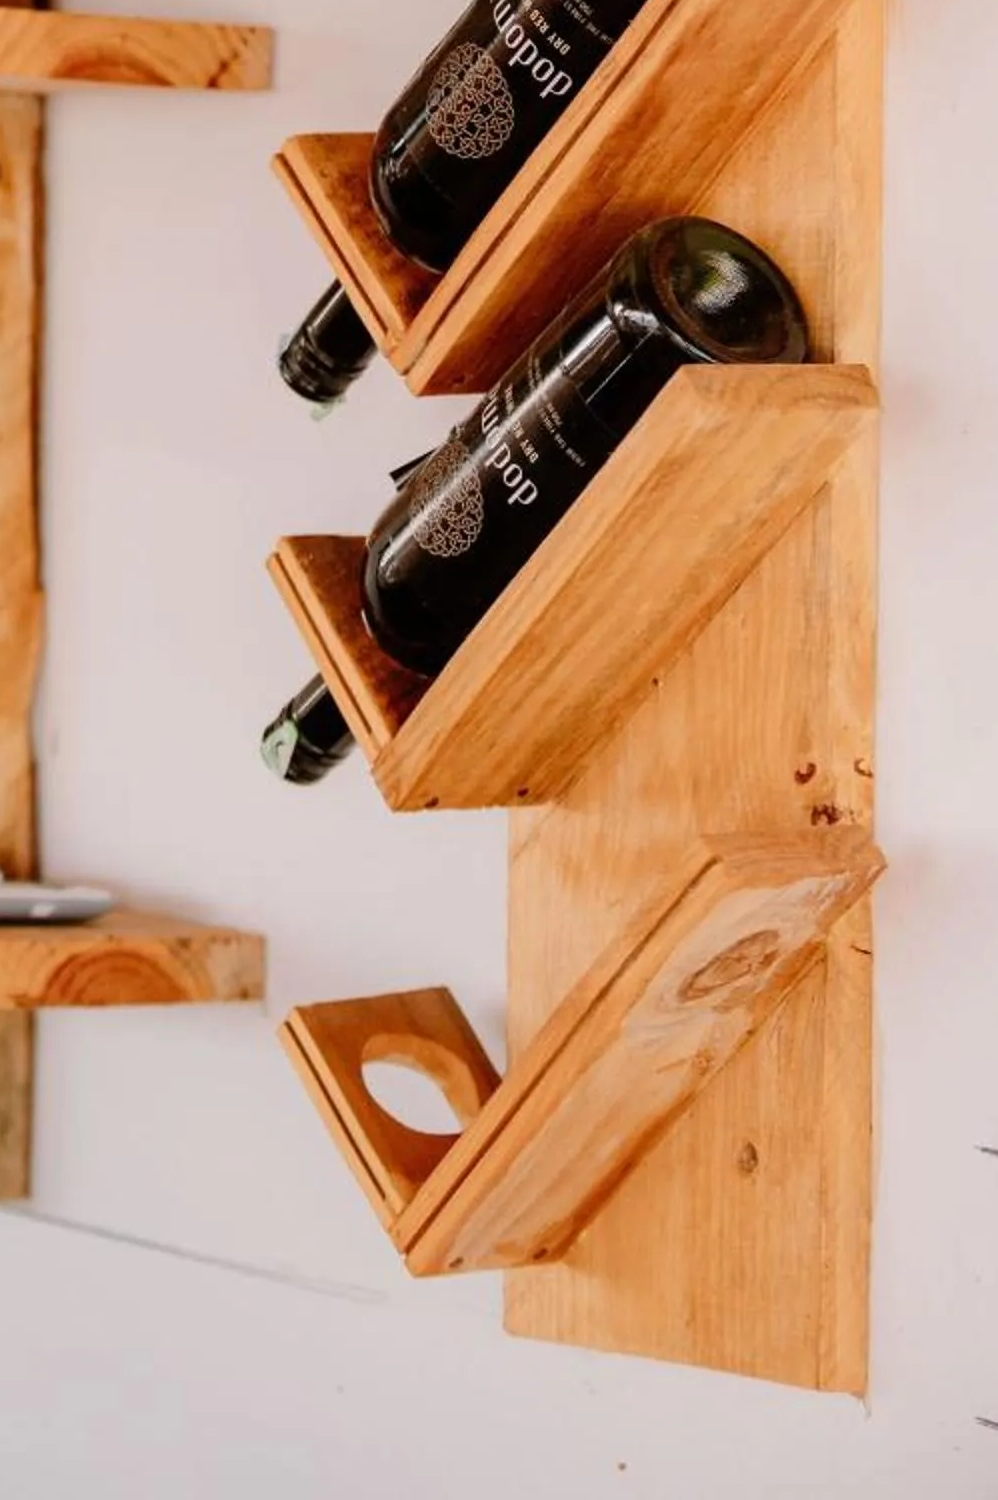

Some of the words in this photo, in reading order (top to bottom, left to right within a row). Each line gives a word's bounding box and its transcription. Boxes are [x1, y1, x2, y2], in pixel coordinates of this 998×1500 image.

[528, 8, 549, 33] RED
[546, 31, 571, 55] DRY
[518, 438, 539, 463] DRY
